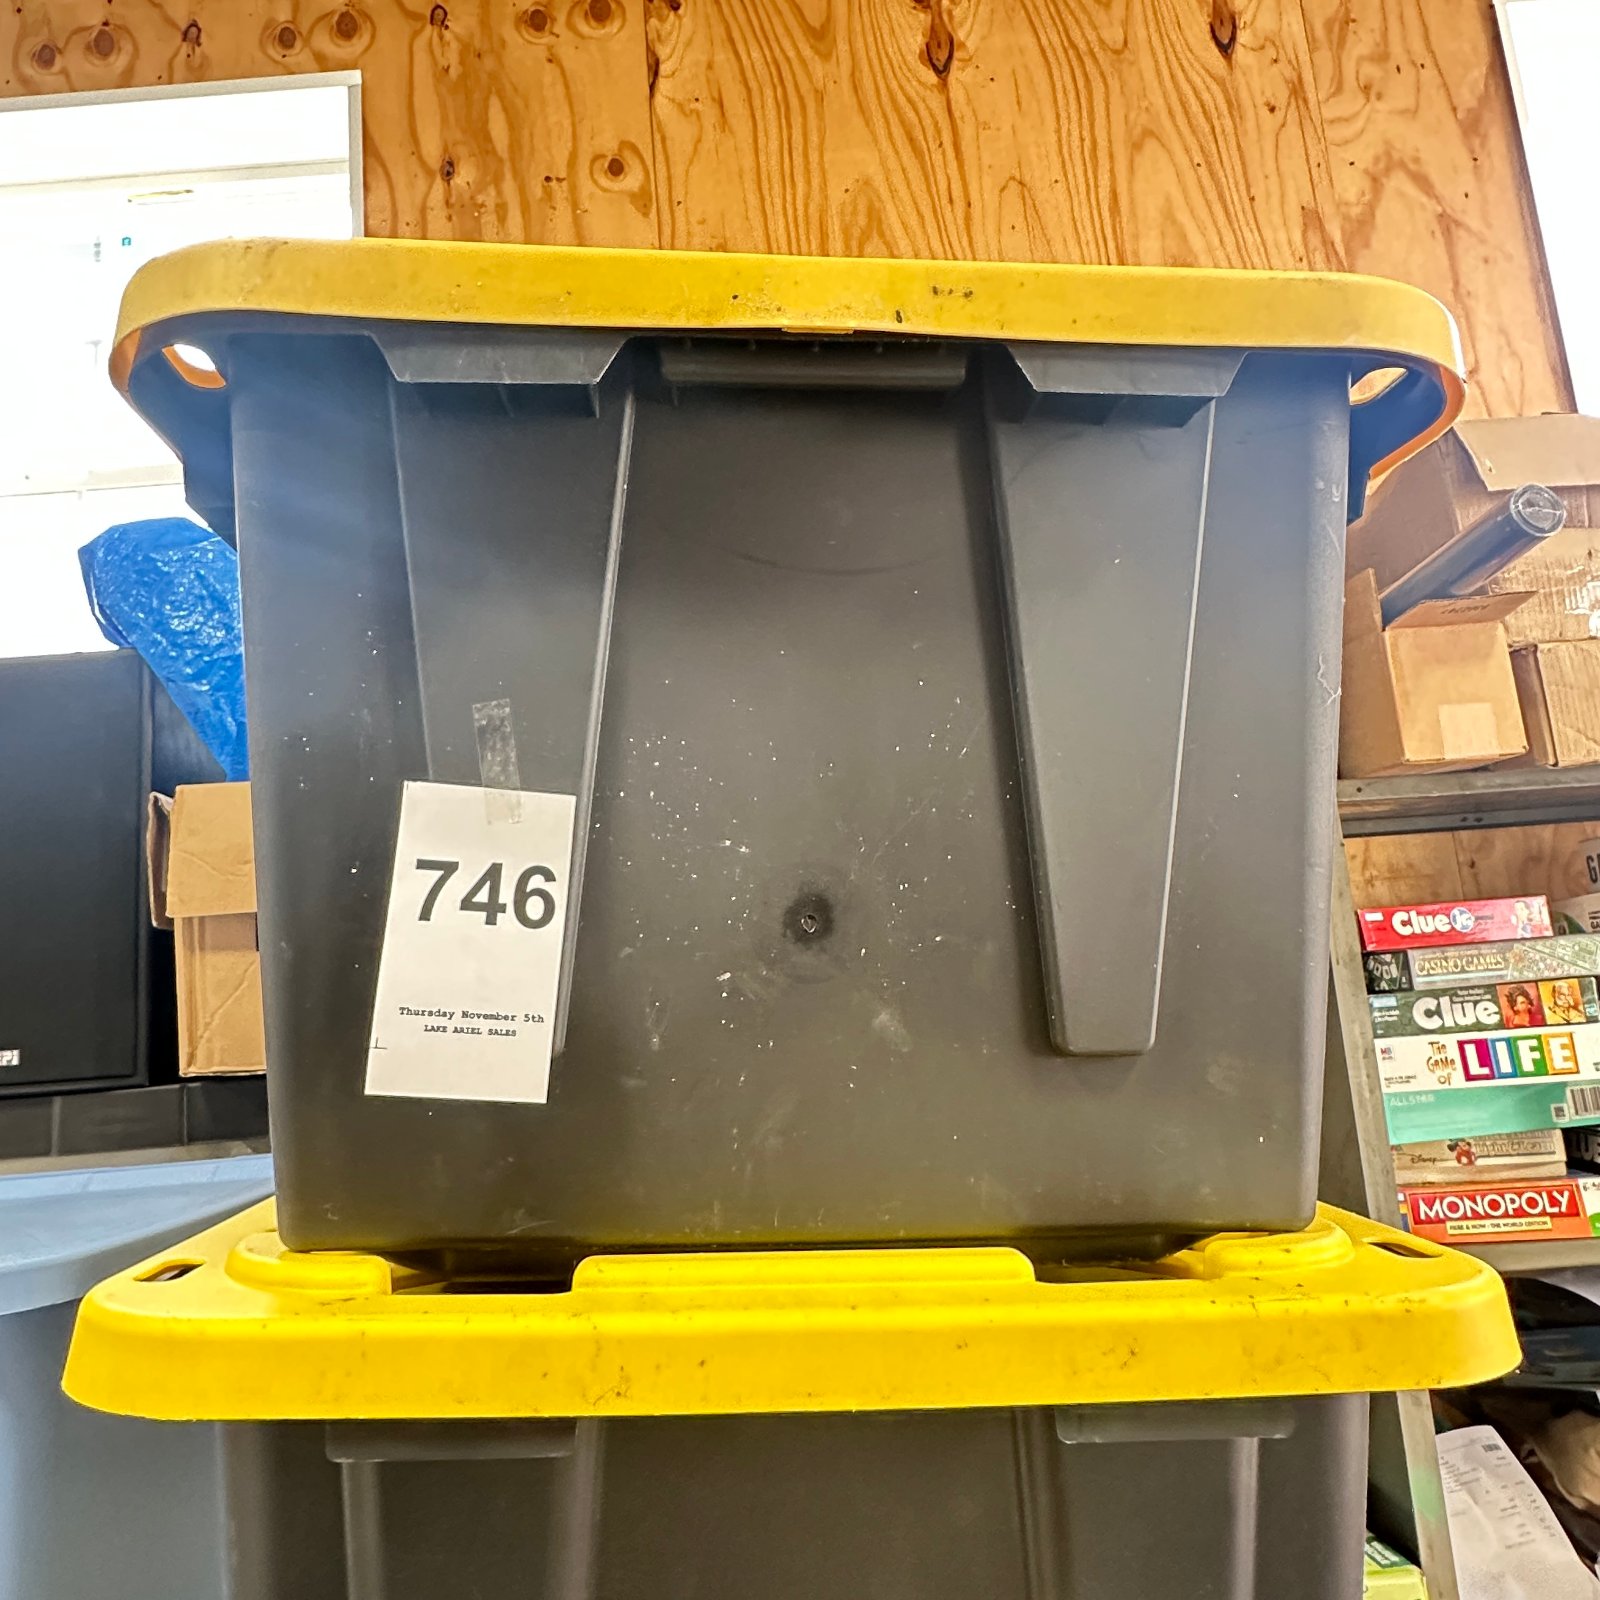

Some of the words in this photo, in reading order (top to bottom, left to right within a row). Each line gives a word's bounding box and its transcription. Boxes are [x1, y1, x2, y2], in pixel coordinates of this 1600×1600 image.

[415, 858, 557, 929] 746
[1392, 909, 1452, 936] Clue
[1415, 957, 1461, 976] CASINO
[1462, 954, 1505, 972] GAMES
[399, 1006, 455, 1020] Thursday
[461, 1010, 517, 1022] November
[523, 1013, 545, 1023] 5th
[1412, 996, 1500, 1030] Clue
[423, 1024, 448, 1033] LAKE
[452, 1026, 482, 1035] ARIEL
[487, 1028, 517, 1037] SALES
[1463, 1036, 1574, 1076] LIFE
[1418, 1190, 1569, 1220] MONOPOLY
